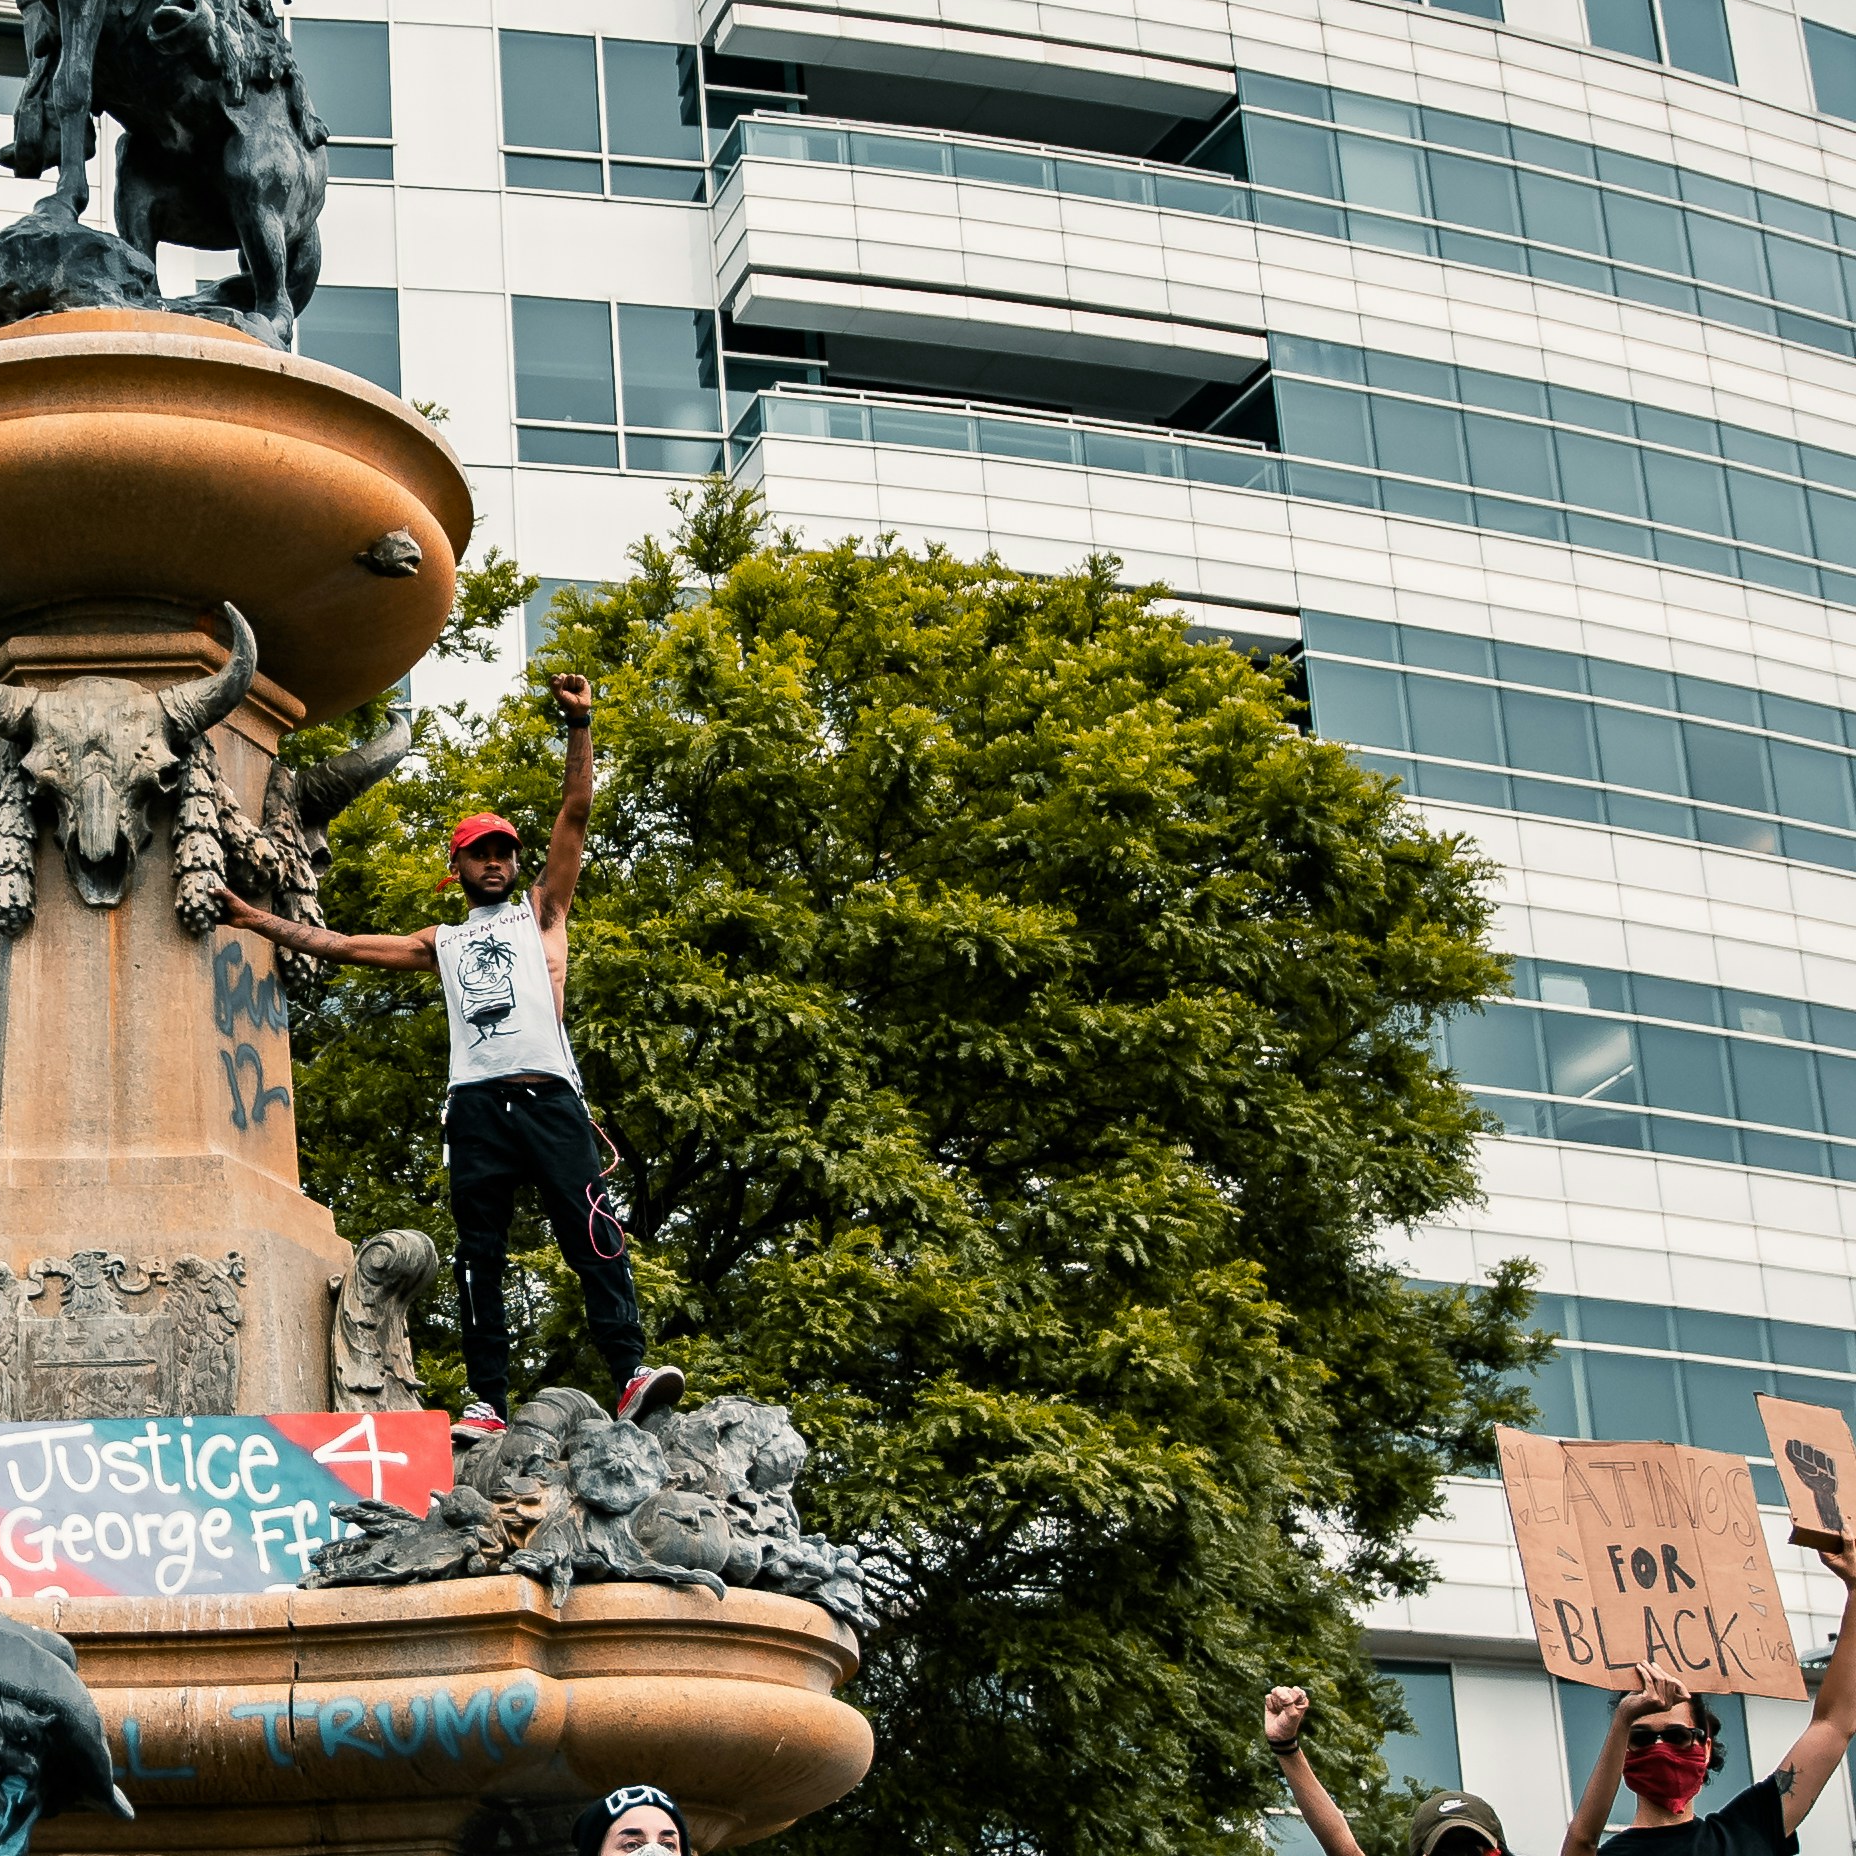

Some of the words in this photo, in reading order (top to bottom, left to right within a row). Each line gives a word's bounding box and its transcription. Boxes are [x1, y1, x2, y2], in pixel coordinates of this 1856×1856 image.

[312, 1412, 409, 1502] 4
[1516, 1443, 1757, 1547] LATINOS
[1606, 1543, 1697, 1595] FOR
[1552, 1597, 1758, 1682] BLACK
[230, 1679, 541, 1766] TRUMP
